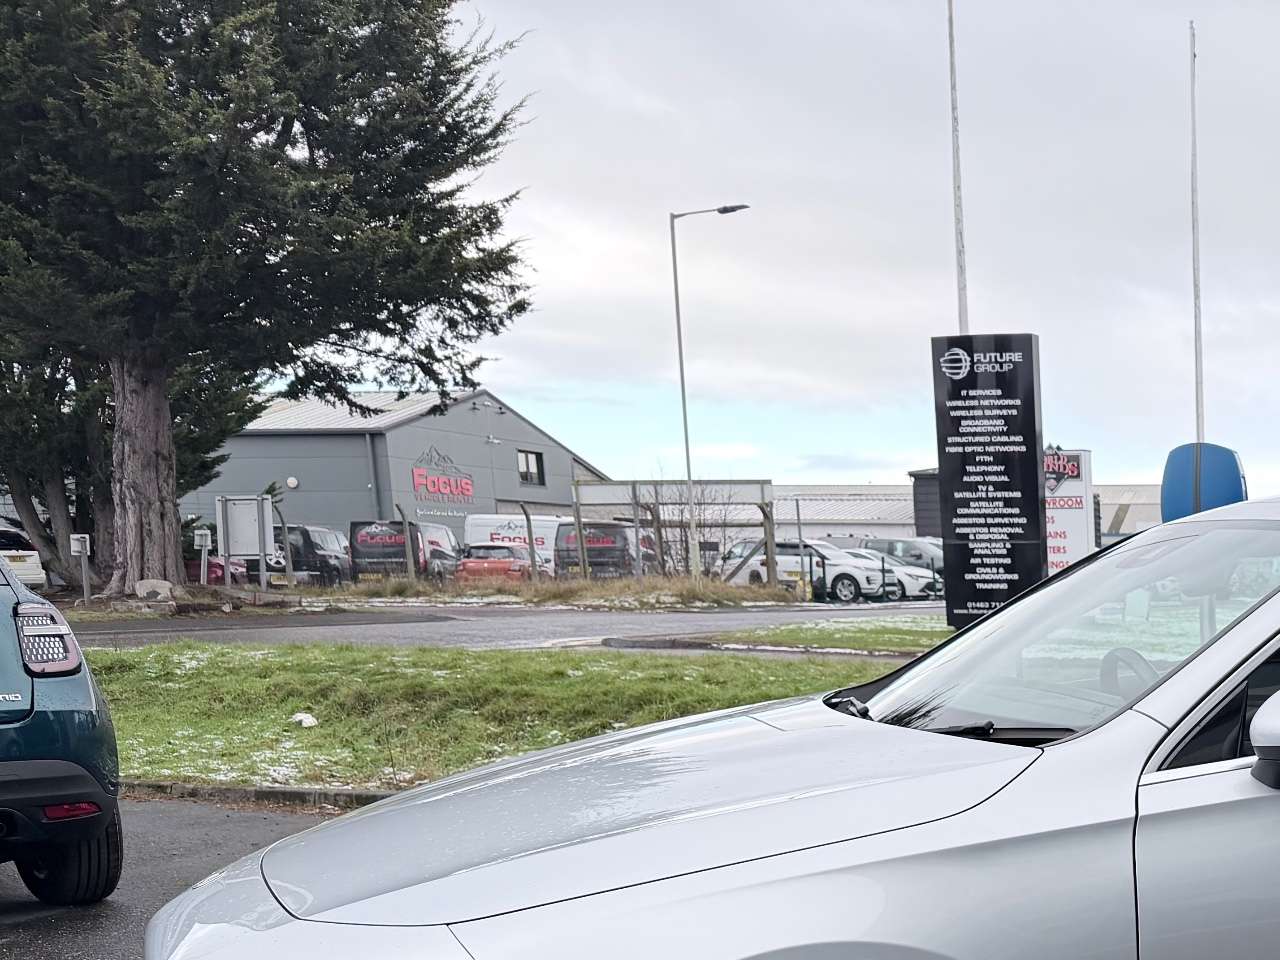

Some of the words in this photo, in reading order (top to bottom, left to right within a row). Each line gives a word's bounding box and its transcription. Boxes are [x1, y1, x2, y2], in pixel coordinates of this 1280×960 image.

[973, 352, 1023, 362] FUTURE
[973, 363, 1014, 373] GROUP
[949, 409, 983, 417] WIRELESS
[947, 435, 990, 443] STRUCTURED
[968, 541, 1004, 549] SAMPLING
